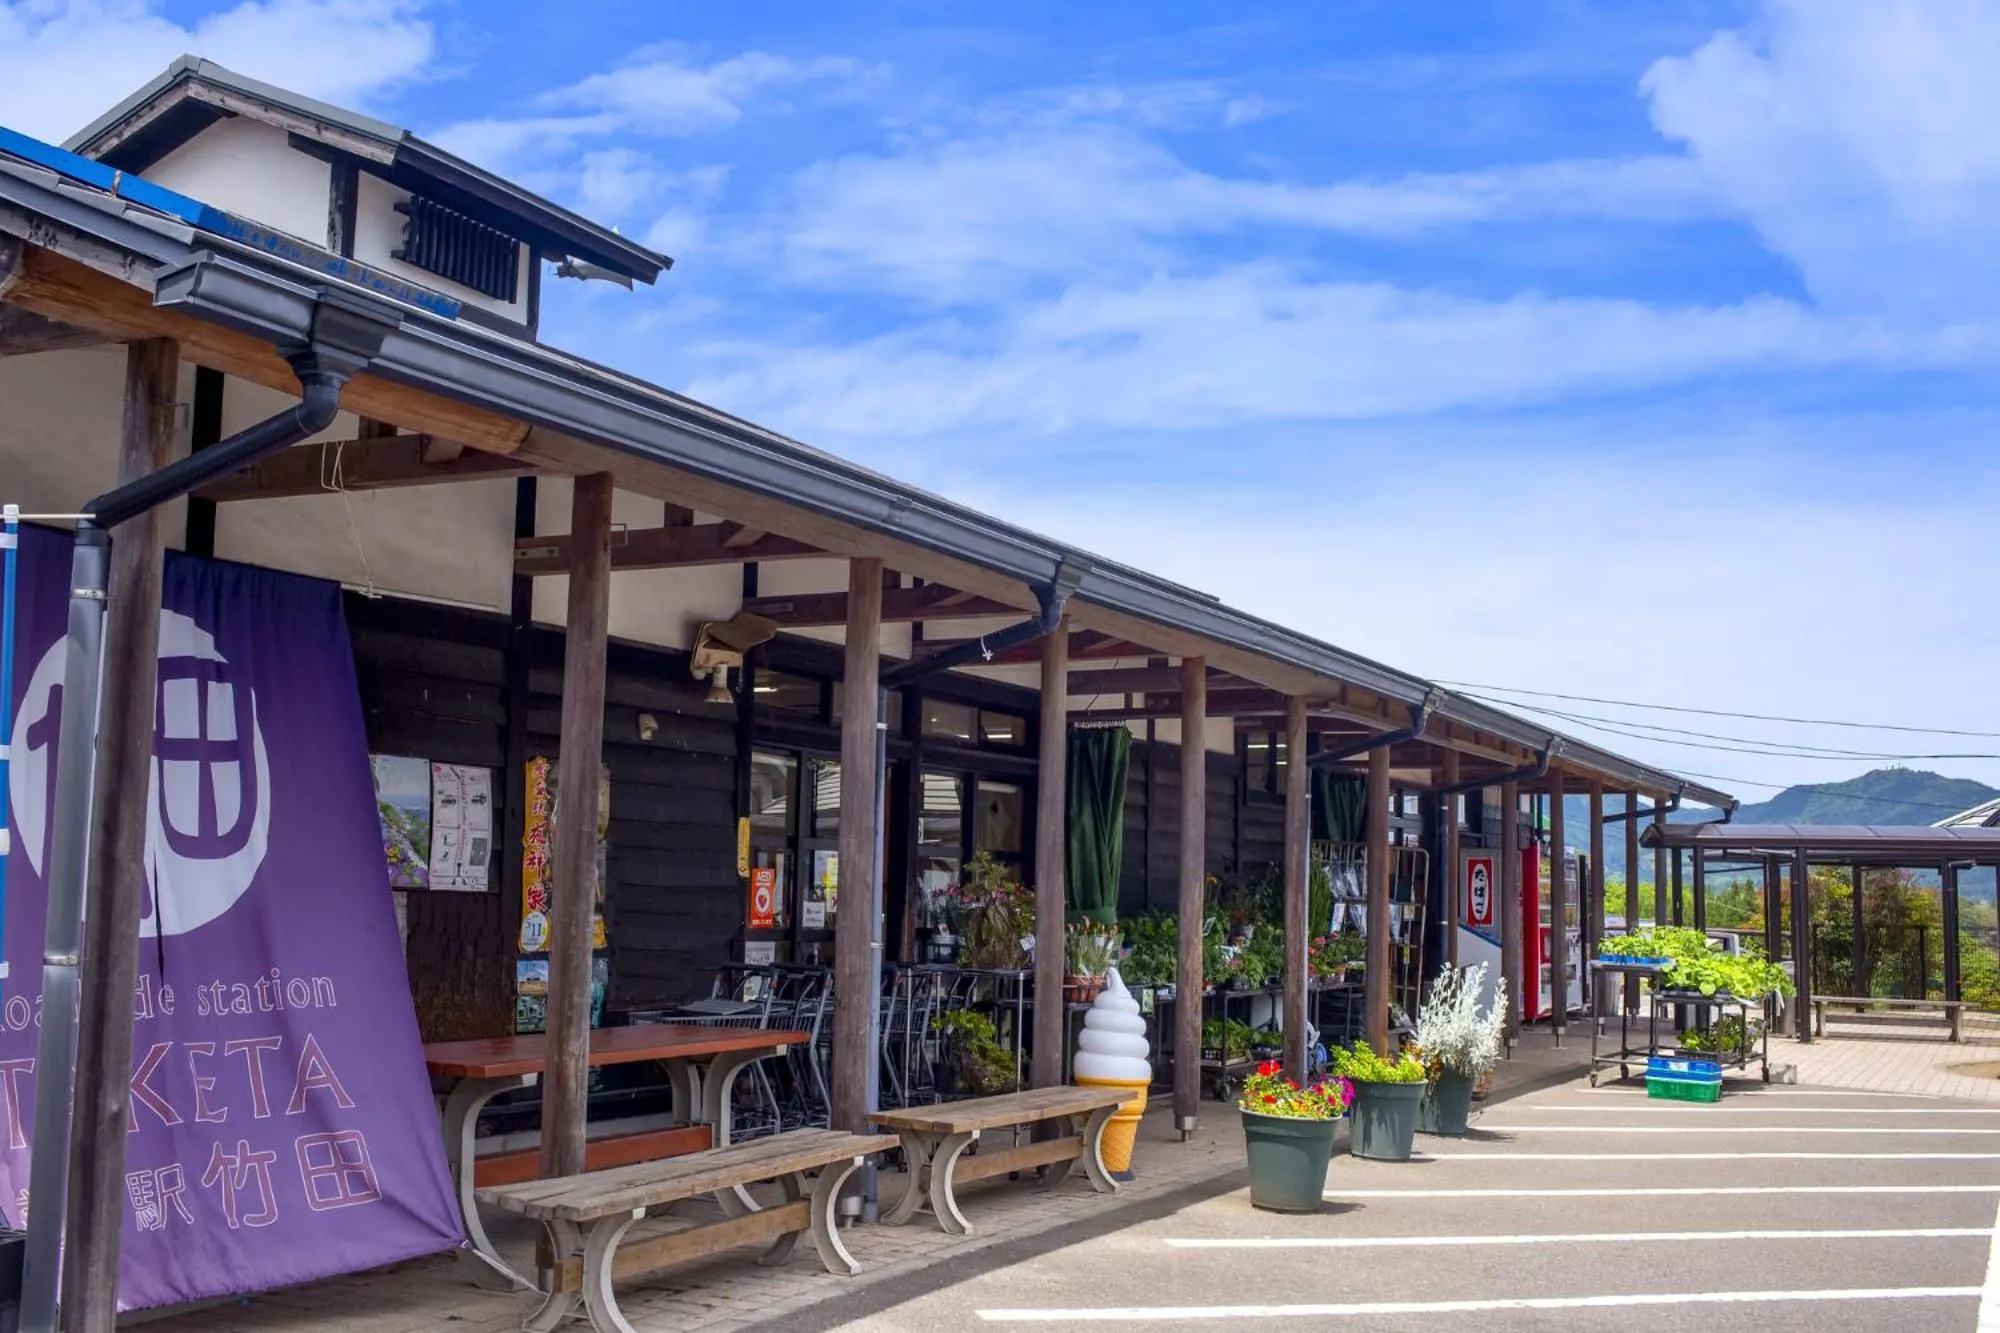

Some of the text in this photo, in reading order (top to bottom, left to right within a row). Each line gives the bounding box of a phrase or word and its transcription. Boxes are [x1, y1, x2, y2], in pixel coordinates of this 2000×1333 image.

[1474, 868, 1488, 915] たばこ
[197, 967, 338, 1016] station
[0, 1032, 356, 1150] TKETA
[16, 1130, 382, 1232] 駅竹田
